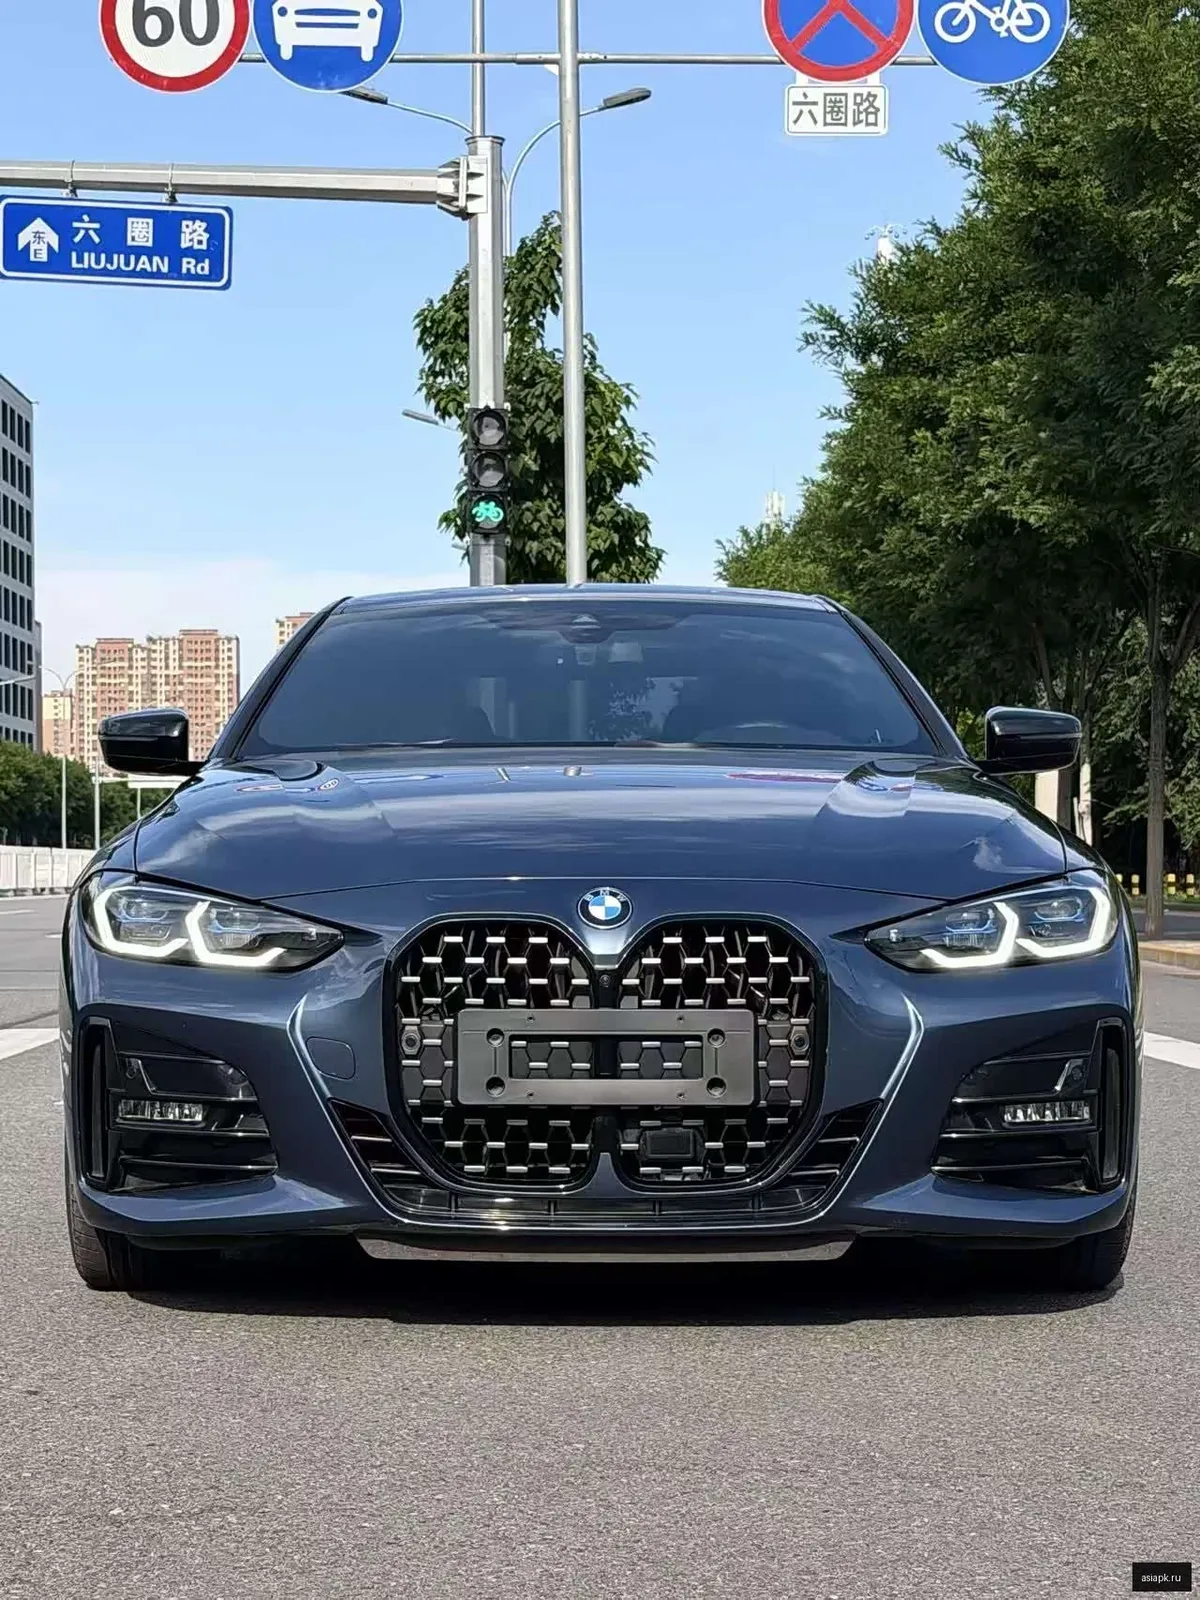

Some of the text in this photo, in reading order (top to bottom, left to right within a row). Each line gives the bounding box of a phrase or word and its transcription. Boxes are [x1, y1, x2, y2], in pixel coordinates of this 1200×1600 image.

[132, 0, 220, 47] 60
[792, 91, 880, 127] 六圈路
[31, 230, 46, 245] 东
[72, 214, 210, 250] 六圈路
[33, 248, 44, 259] E
[71, 251, 210, 275] LIUJUAN Rd
[584, 889, 627, 902] BMW
